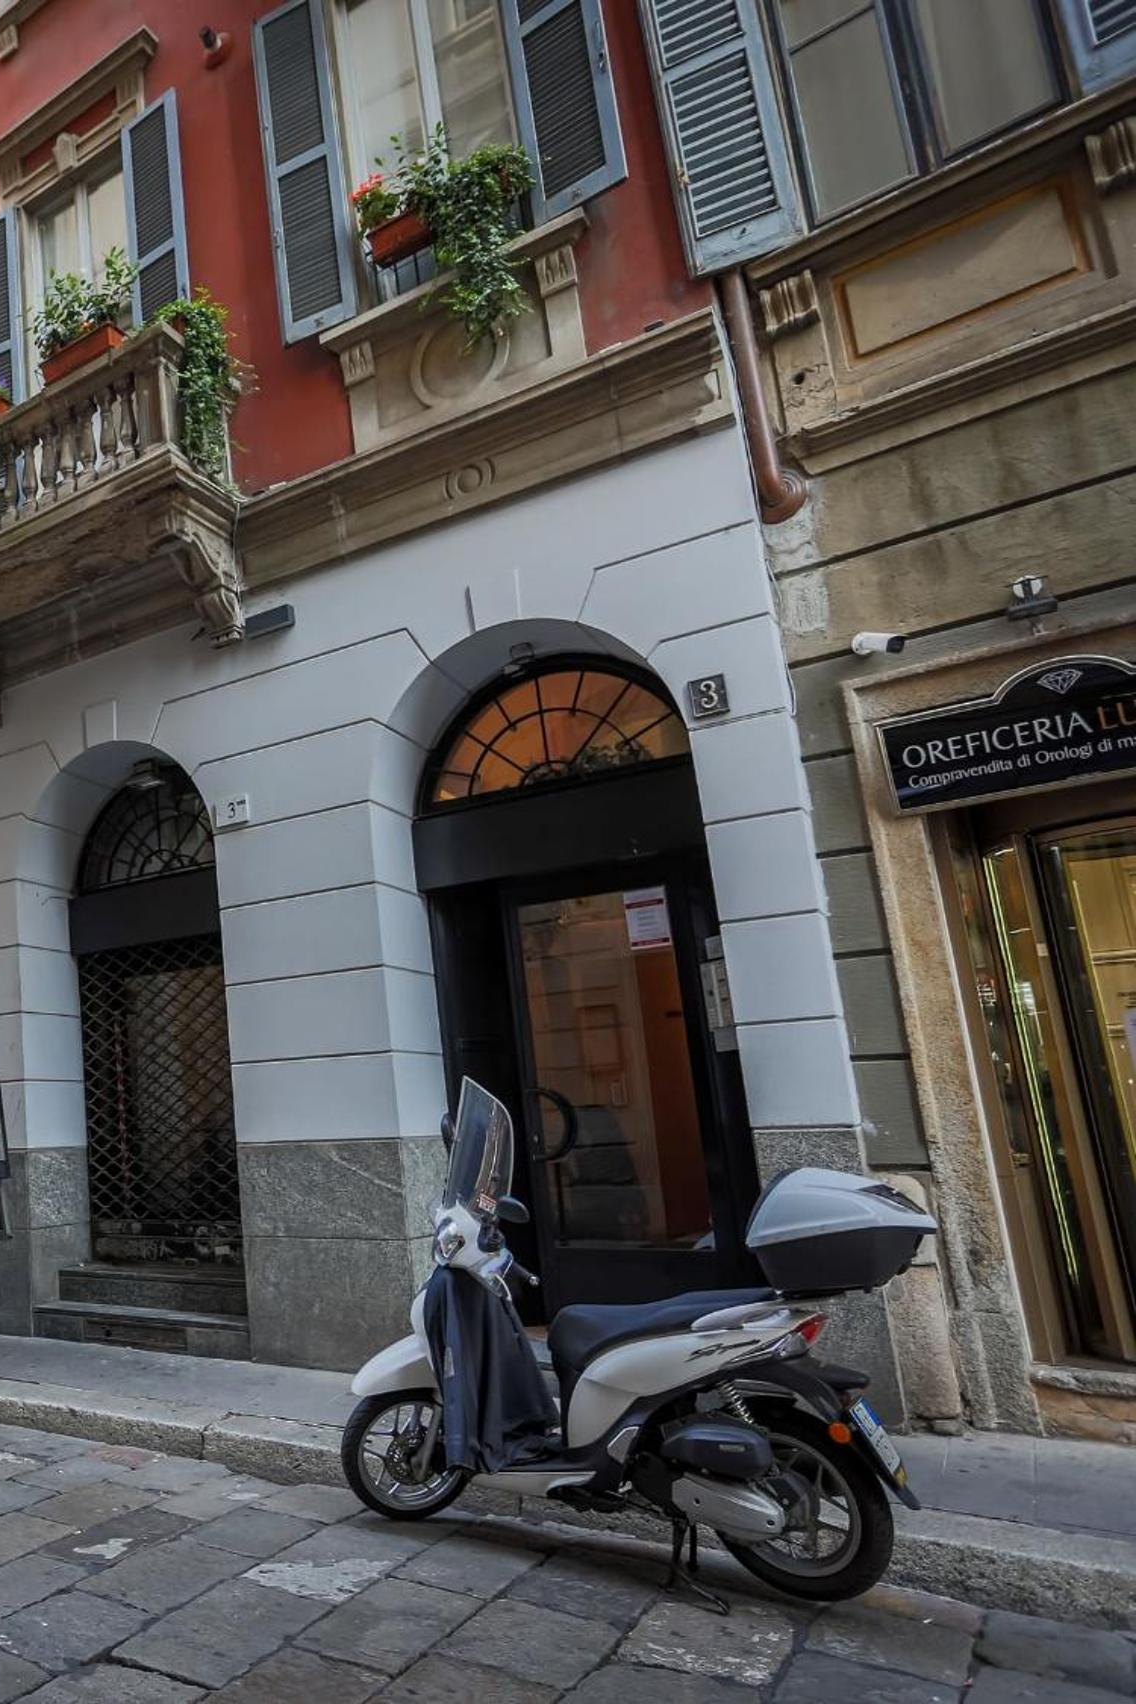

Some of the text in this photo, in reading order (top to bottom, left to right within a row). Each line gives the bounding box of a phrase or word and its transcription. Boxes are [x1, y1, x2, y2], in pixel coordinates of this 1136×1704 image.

[700, 680, 718, 709] 3
[902, 711, 1094, 768] OREFICERIA
[909, 736, 1136, 789] Compravendita di Orologi di m
